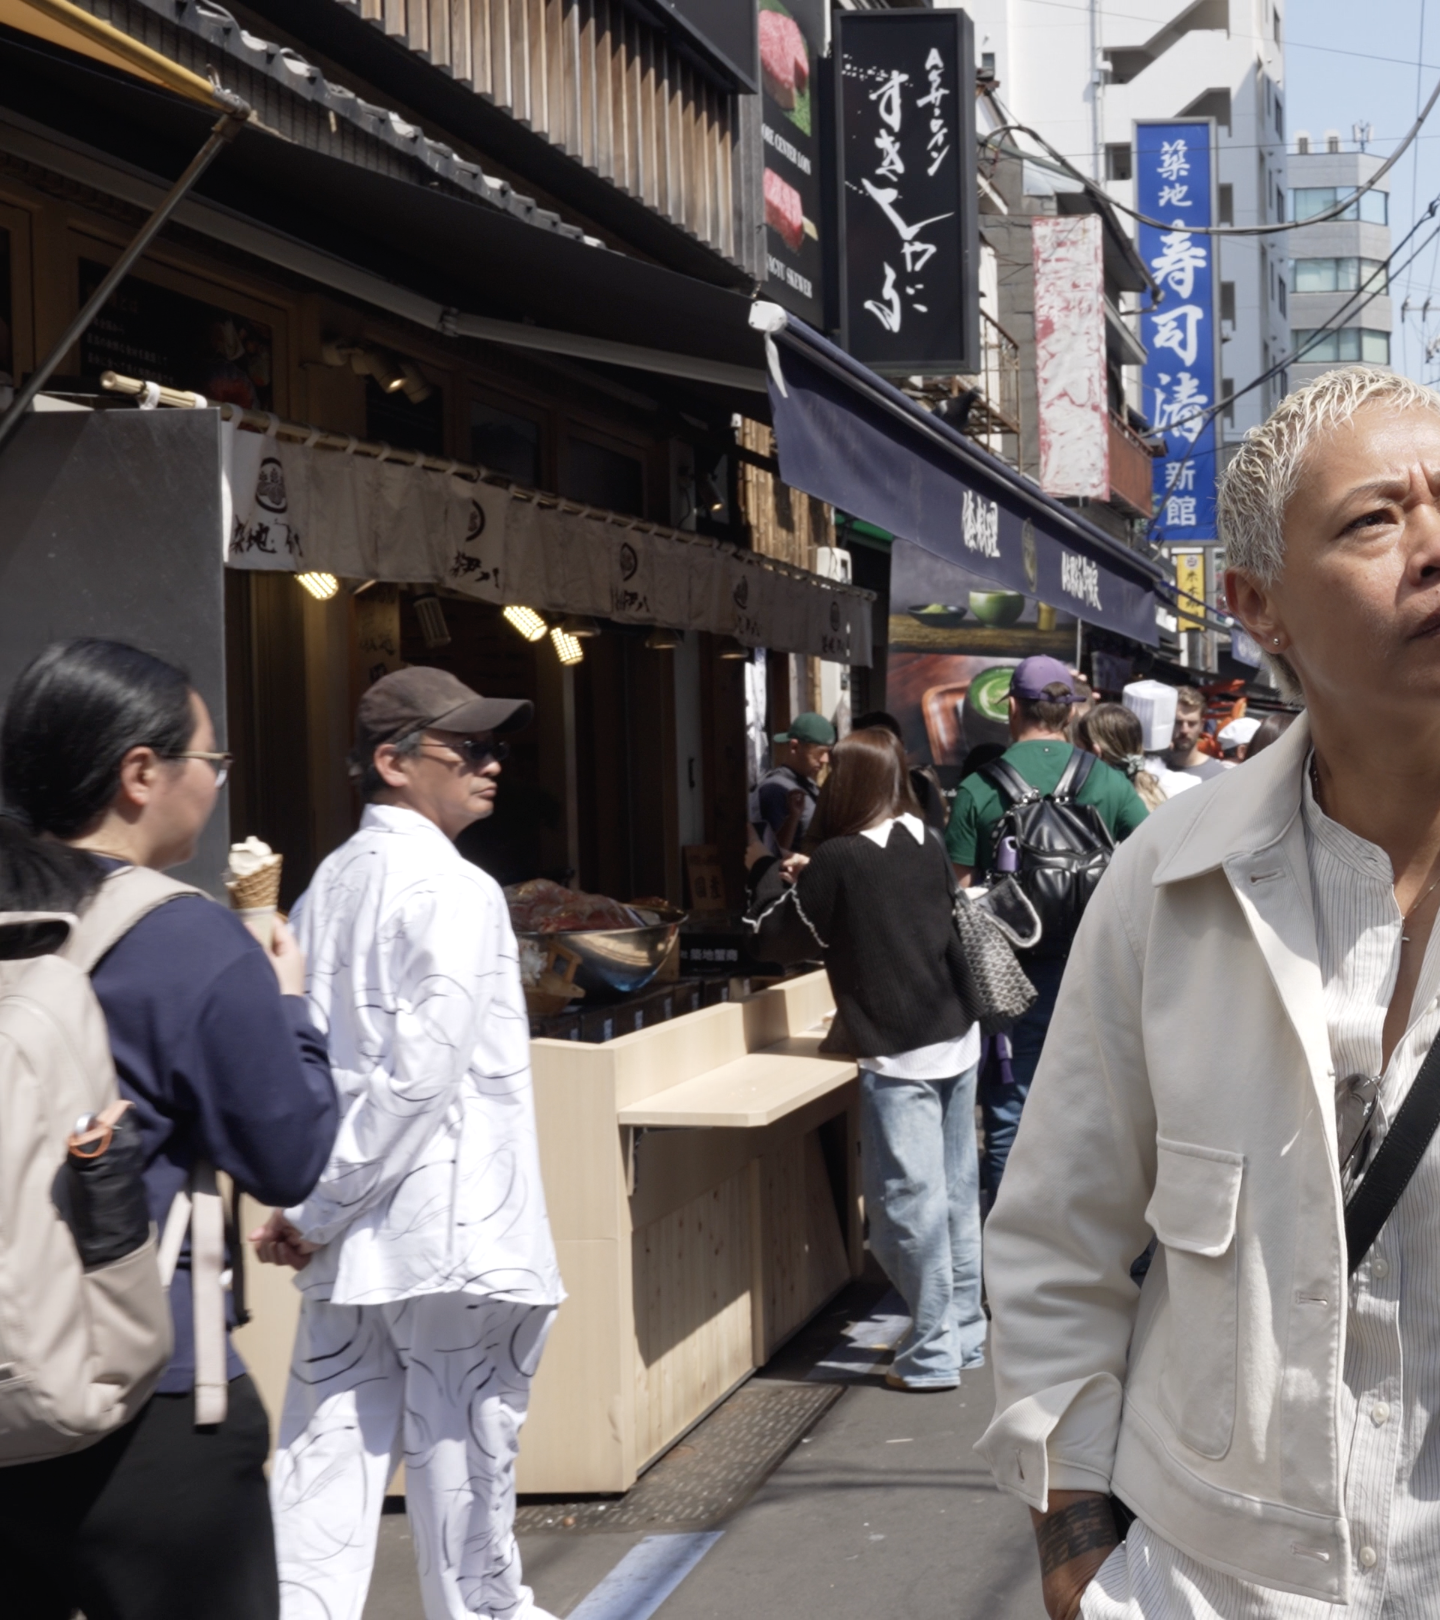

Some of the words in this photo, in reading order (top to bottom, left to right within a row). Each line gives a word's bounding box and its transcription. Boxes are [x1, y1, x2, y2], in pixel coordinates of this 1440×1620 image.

[1156, 139, 1193, 208] 築地
[1151, 218, 1208, 444] 寿司清
[1165, 460, 1198, 527] 新館
